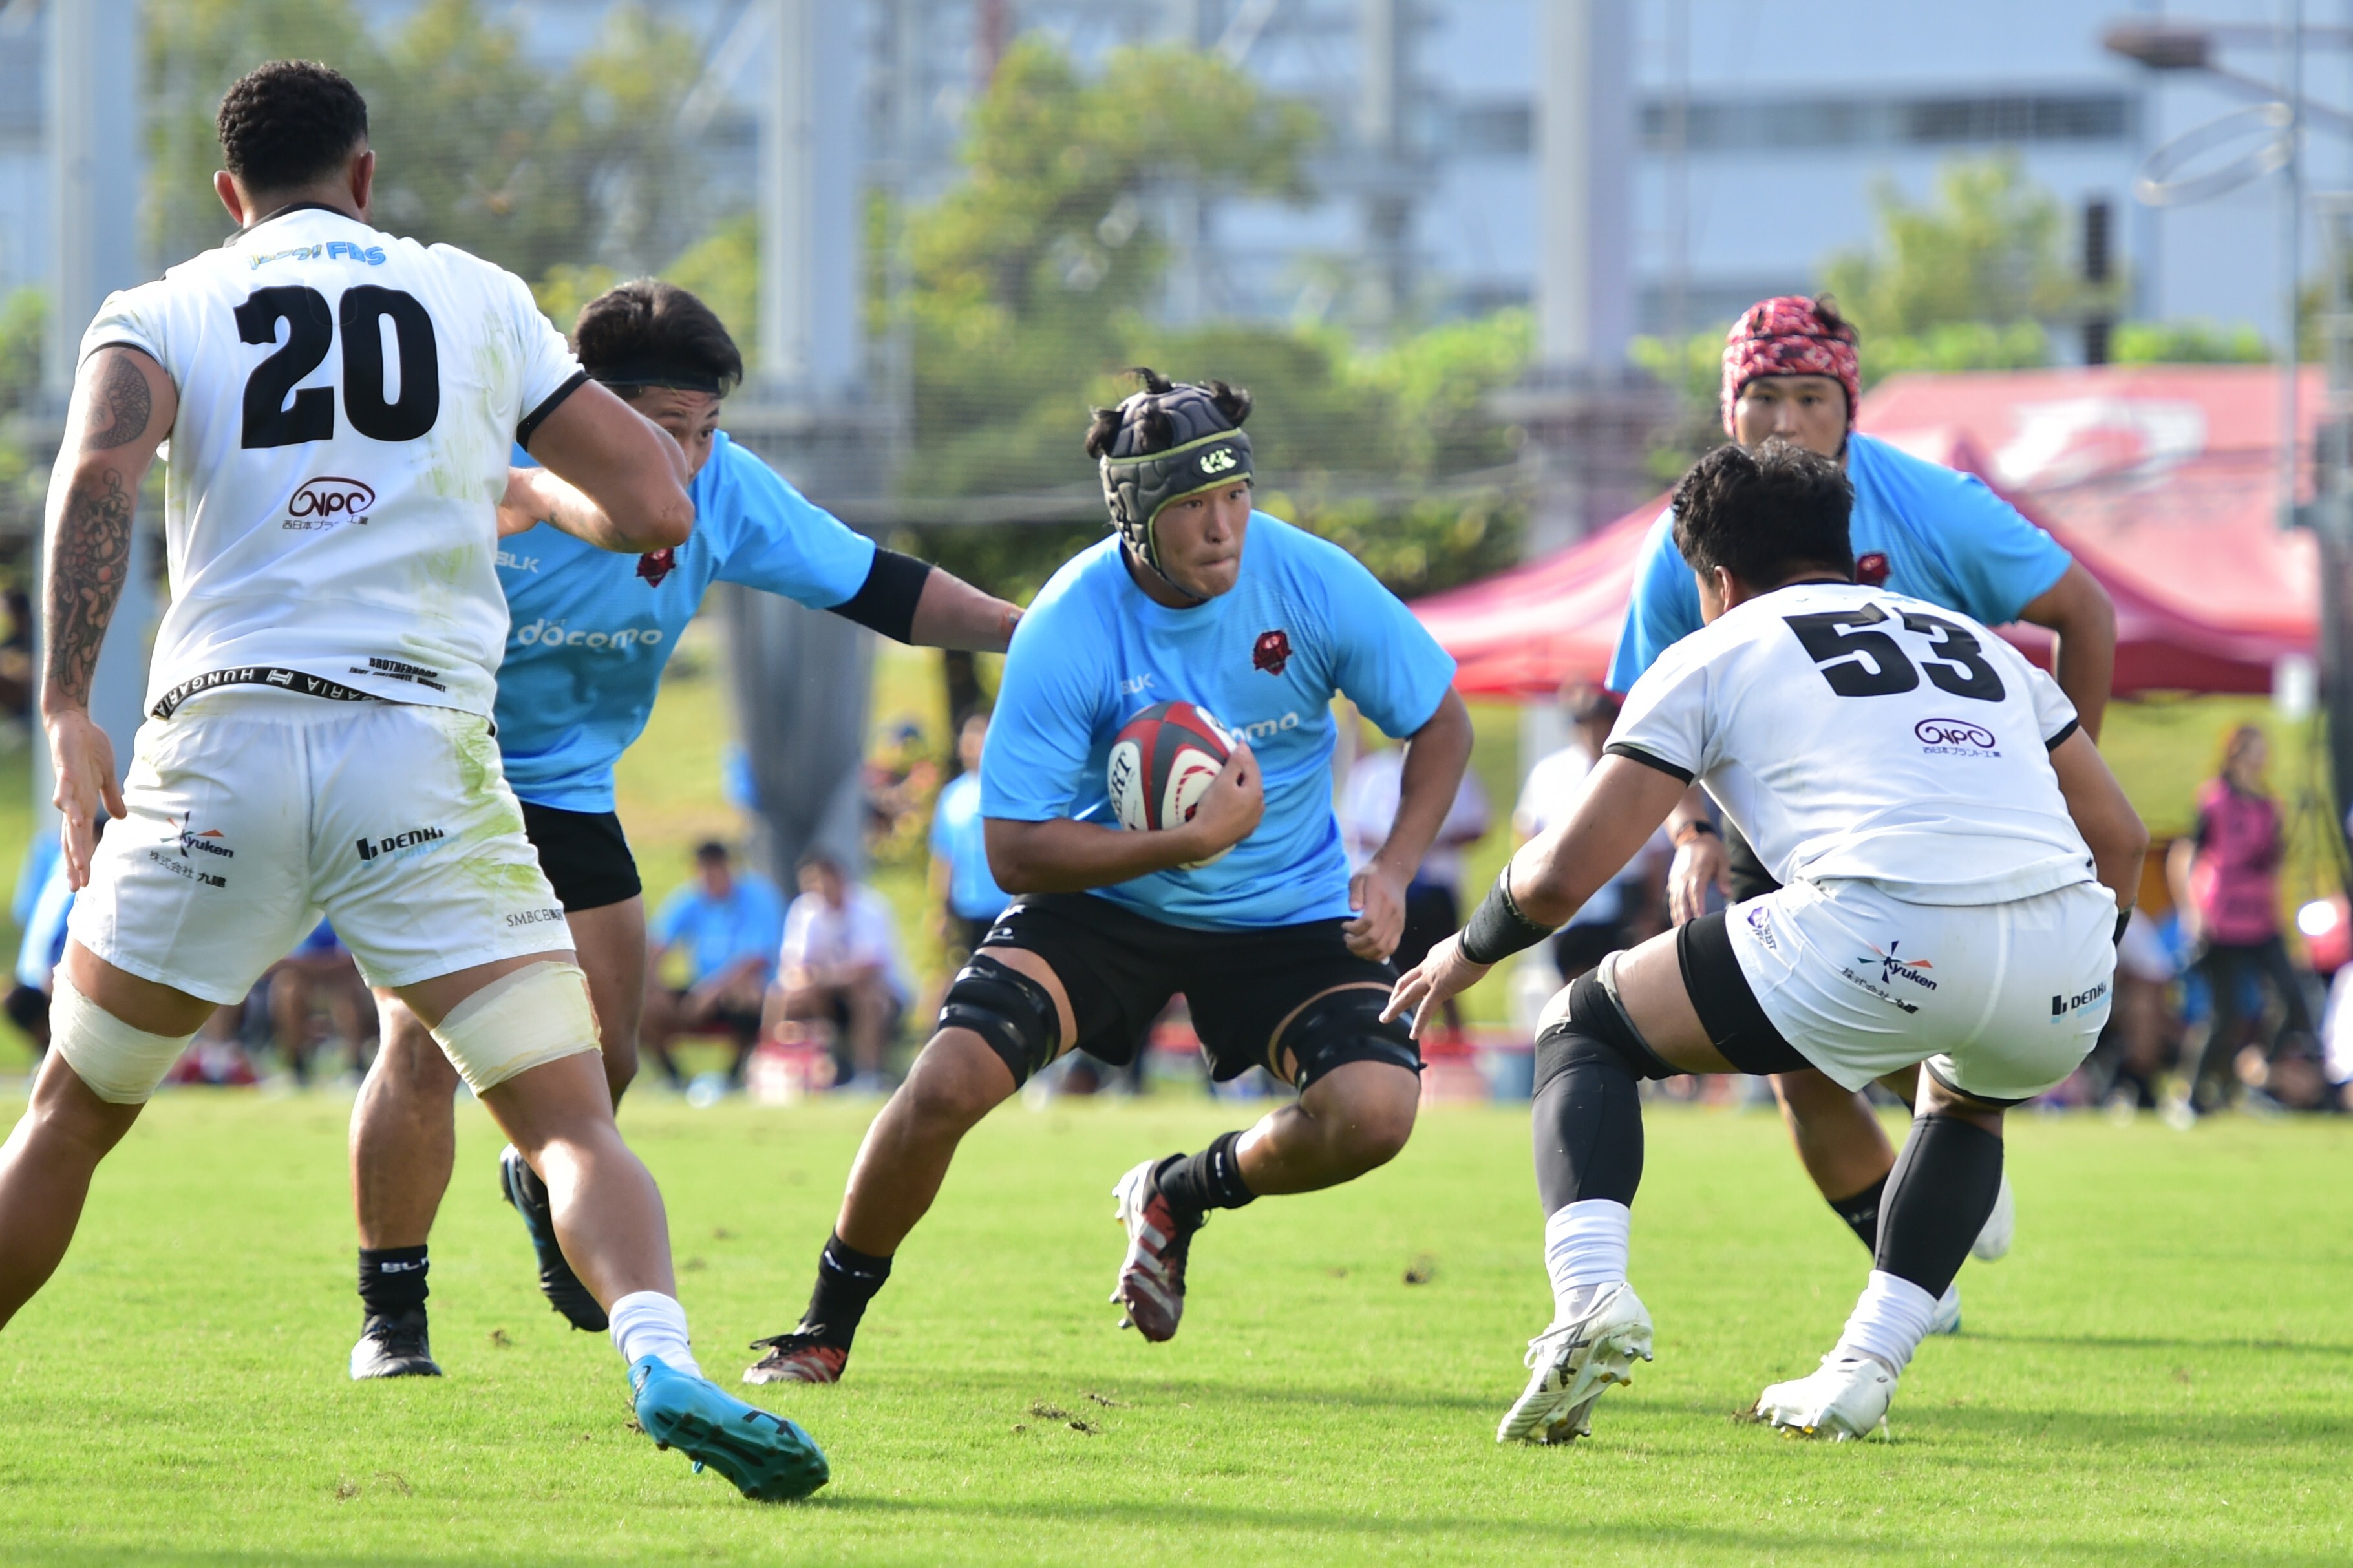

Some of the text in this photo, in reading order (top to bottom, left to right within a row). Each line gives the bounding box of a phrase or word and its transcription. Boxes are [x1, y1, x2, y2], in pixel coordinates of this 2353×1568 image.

[326, 241, 386, 266] FBS
[233, 284, 440, 449] 20
[518, 618, 663, 648] docomo
[1782, 602, 2005, 702] 53
[155, 669, 255, 716] HUNGARIA
[180, 829, 234, 858] Kyuken
[1883, 956, 1938, 991] Kyuken
